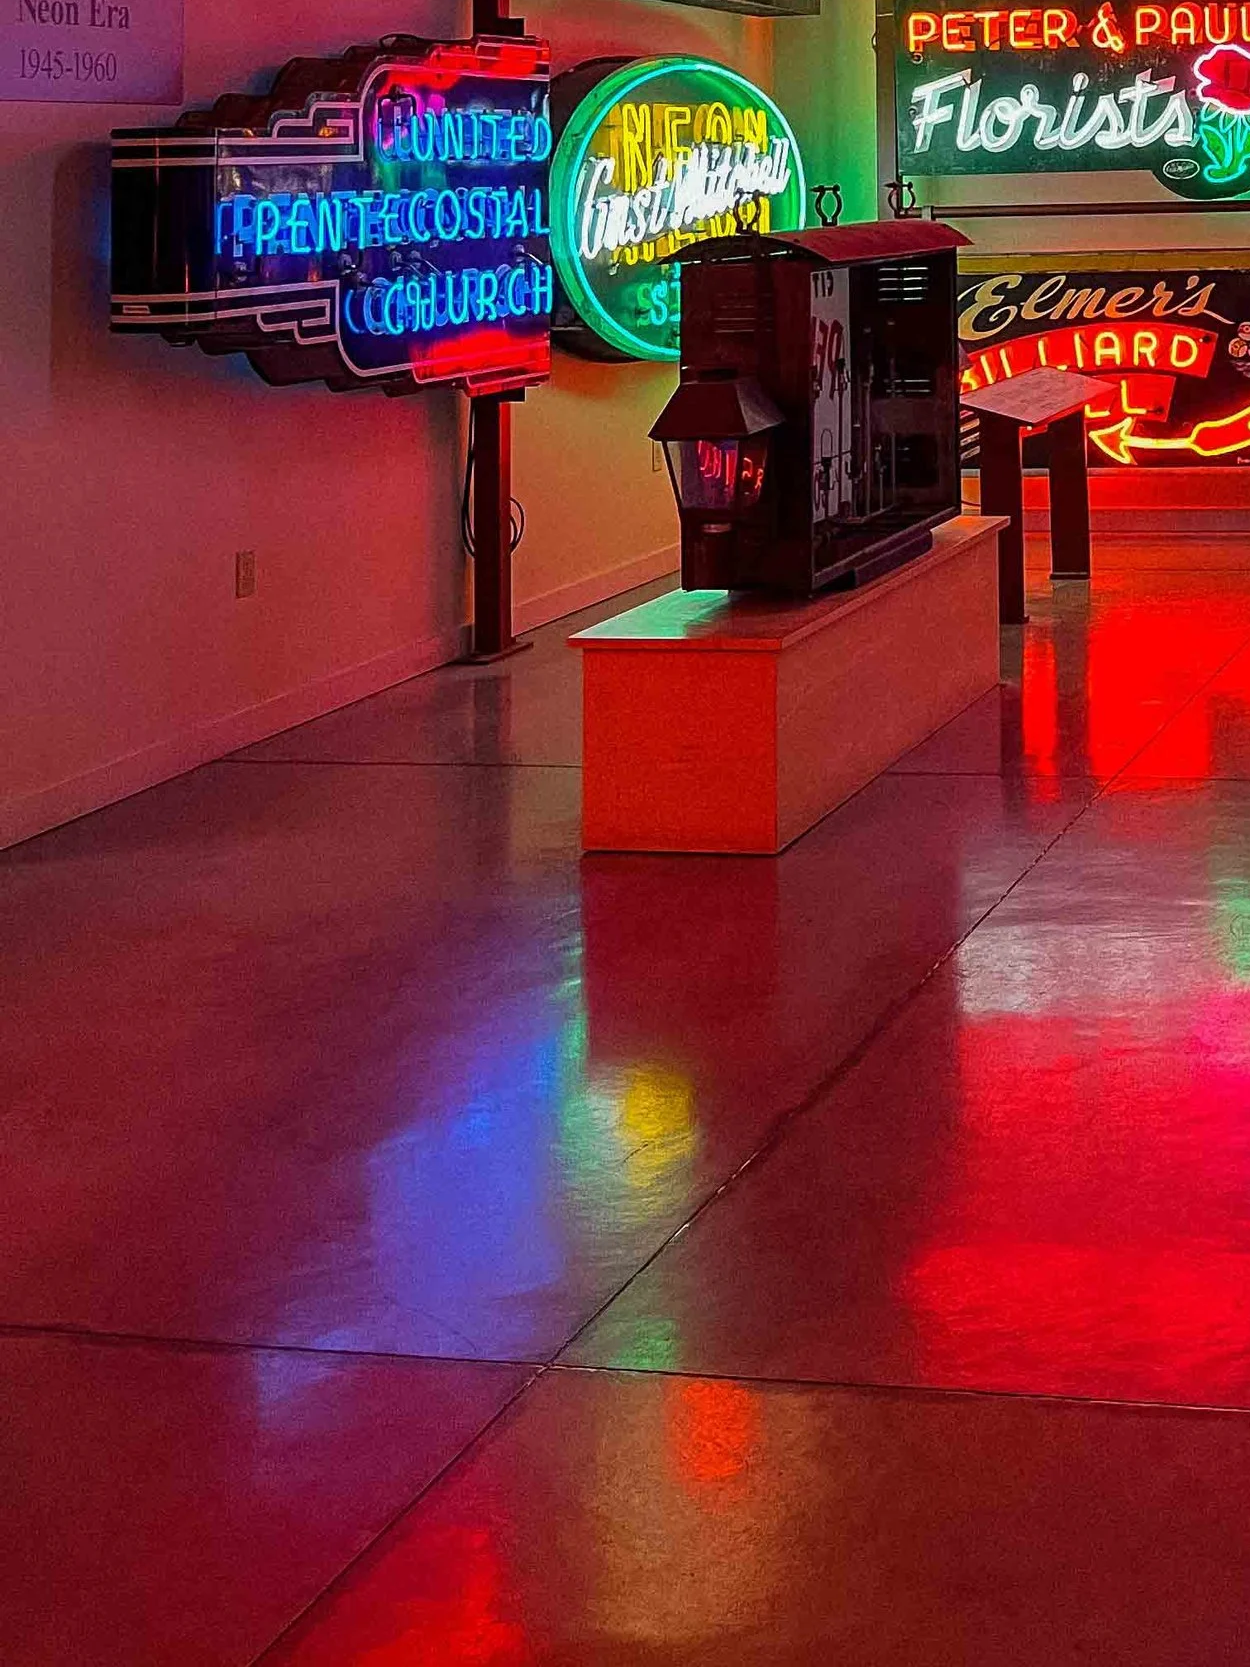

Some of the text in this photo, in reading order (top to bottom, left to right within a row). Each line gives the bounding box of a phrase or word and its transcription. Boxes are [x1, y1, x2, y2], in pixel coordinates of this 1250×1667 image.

[908, 6, 1080, 55] PETER
[1091, 0, 1126, 55] &
[19, 48, 118, 82] 1945-1960
[408, 111, 552, 163] UNITED
[911, 67, 1199, 154] Florists
[254, 188, 551, 256] PENTECOSTAL
[382, 264, 553, 335] CHURCH
[957, 274, 1235, 341] Elmer's
